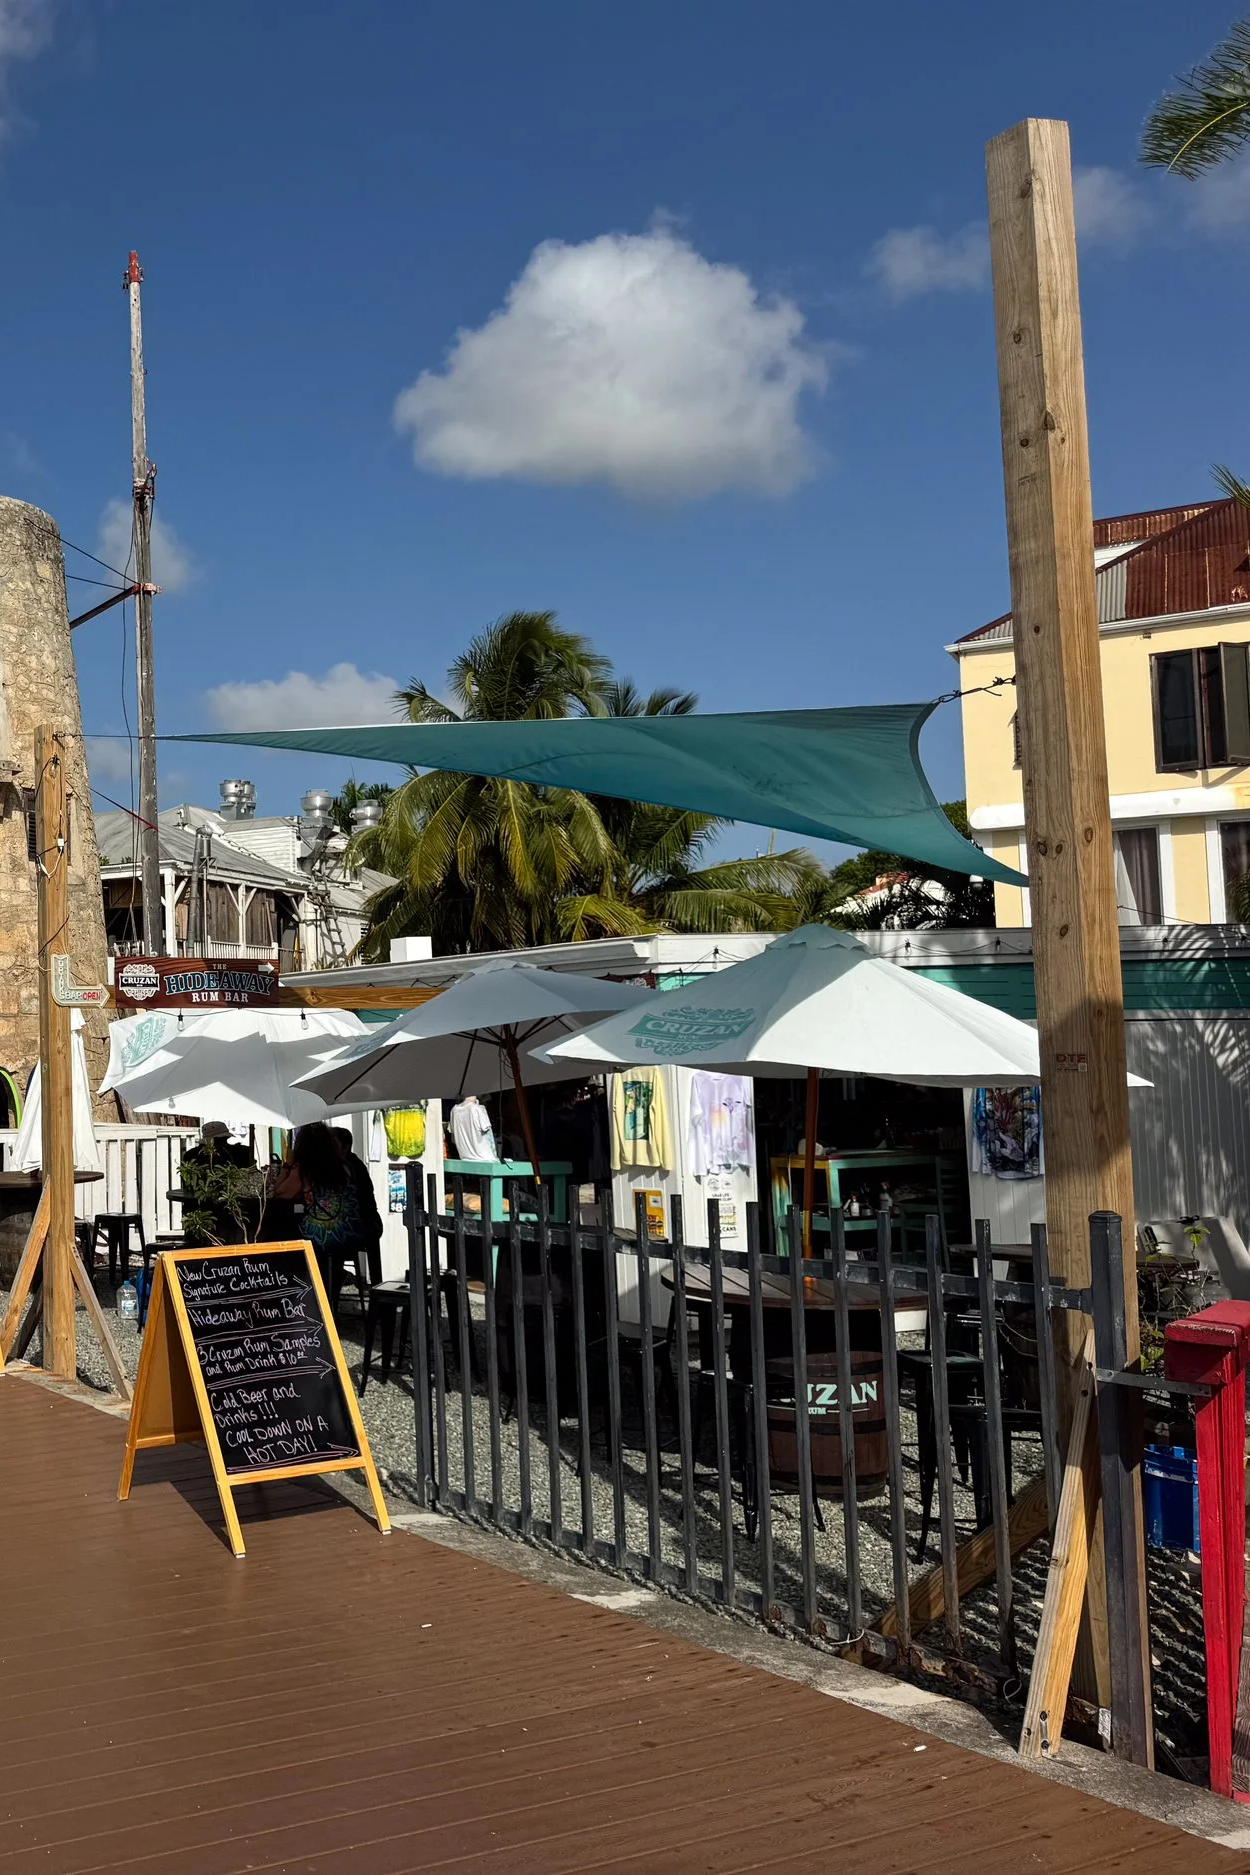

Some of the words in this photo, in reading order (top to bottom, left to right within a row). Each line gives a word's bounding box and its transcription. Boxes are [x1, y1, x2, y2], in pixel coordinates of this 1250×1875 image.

[164, 971, 274, 995] HIDEAWAY
[82, 992, 100, 1001] OPEN
[191, 992, 219, 1003] RUM
[225, 992, 249, 1002] BAR
[646, 1020, 743, 1035] CRUZAN
[177, 1265, 202, 1282] New
[202, 1260, 242, 1280] Cruzan
[242, 1257, 271, 1274] Rum
[183, 1282, 227, 1301] Signature
[229, 1271, 289, 1292] Cocktails
[187, 1305, 254, 1329] Hideaway
[251, 1300, 282, 1320] Rum
[281, 1298, 307, 1318] Bar
[197, 1346, 209, 1366] 3
[209, 1345, 245, 1363] Cruzan
[243, 1337, 271, 1354] Rum
[271, 1332, 321, 1352] Samples
[205, 1363, 223, 1376] and
[224, 1360, 246, 1374] Rum
[244, 1355, 278, 1370] Drink
[211, 1391, 242, 1412] Cold
[237, 1388, 268, 1405] Beer
[272, 1382, 302, 1401] and
[214, 1407, 258, 1429] Drinks
[226, 1430, 254, 1448] COOL
[253, 1419, 293, 1441] DOWN
[295, 1414, 314, 1432] ON
[316, 1415, 330, 1432] A
[243, 1443, 278, 1465] HOT
[276, 1434, 318, 1456] DAY!
